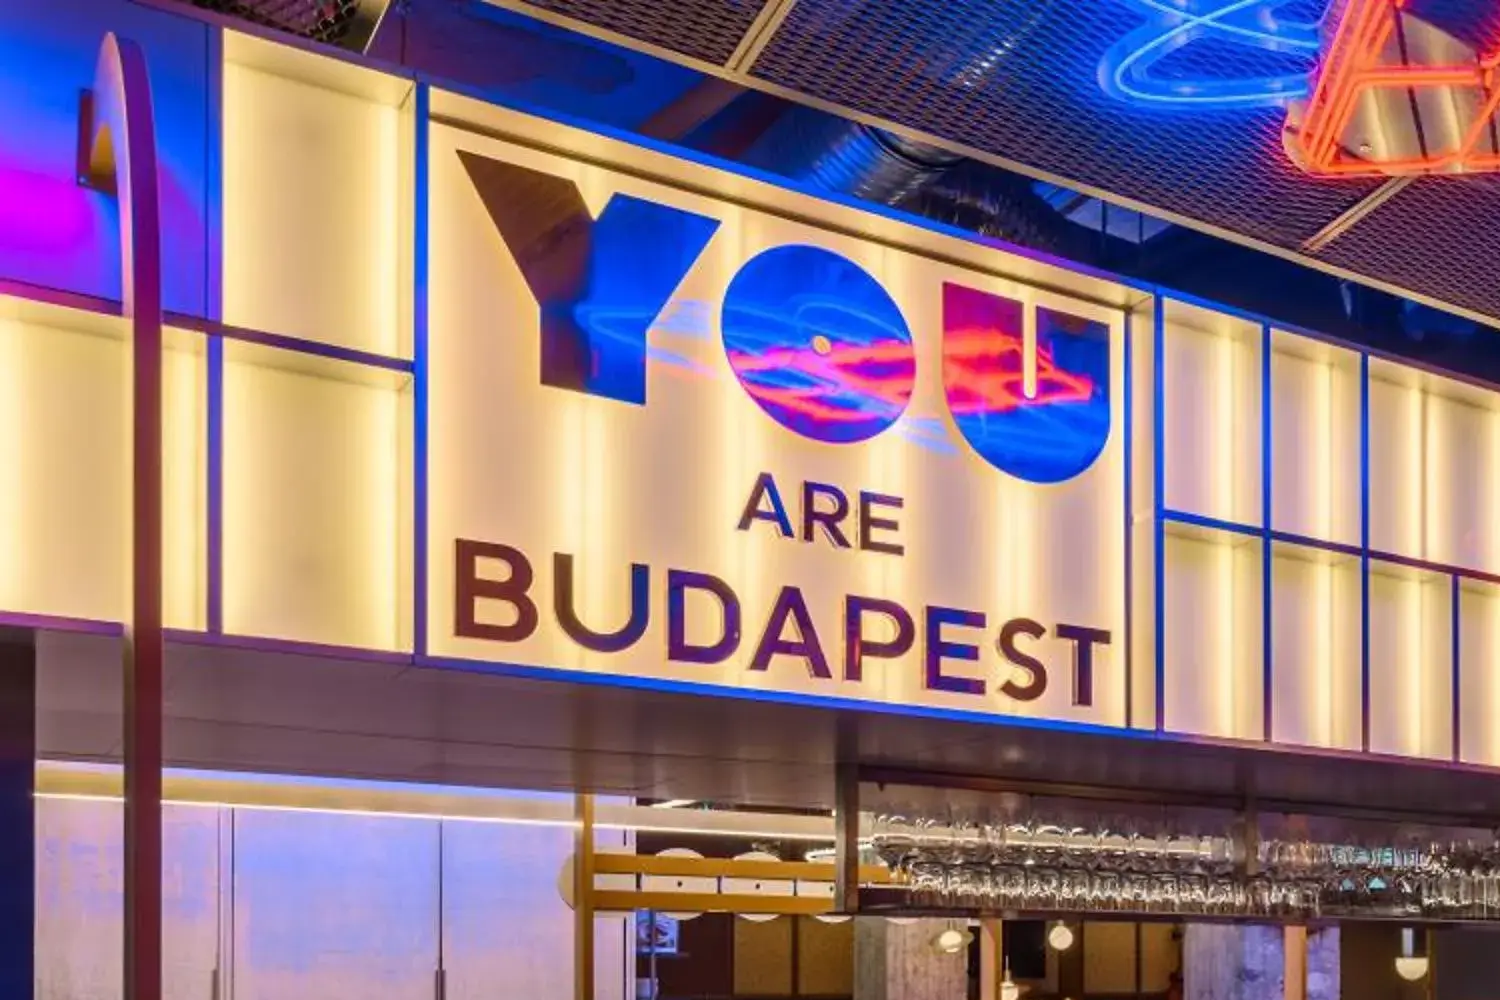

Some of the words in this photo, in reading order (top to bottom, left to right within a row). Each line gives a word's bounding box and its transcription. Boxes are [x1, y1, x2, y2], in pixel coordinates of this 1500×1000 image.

[455, 148, 1111, 484] YOU
[737, 472, 904, 556] ARE
[453, 537, 1111, 706] BUDAPEST
